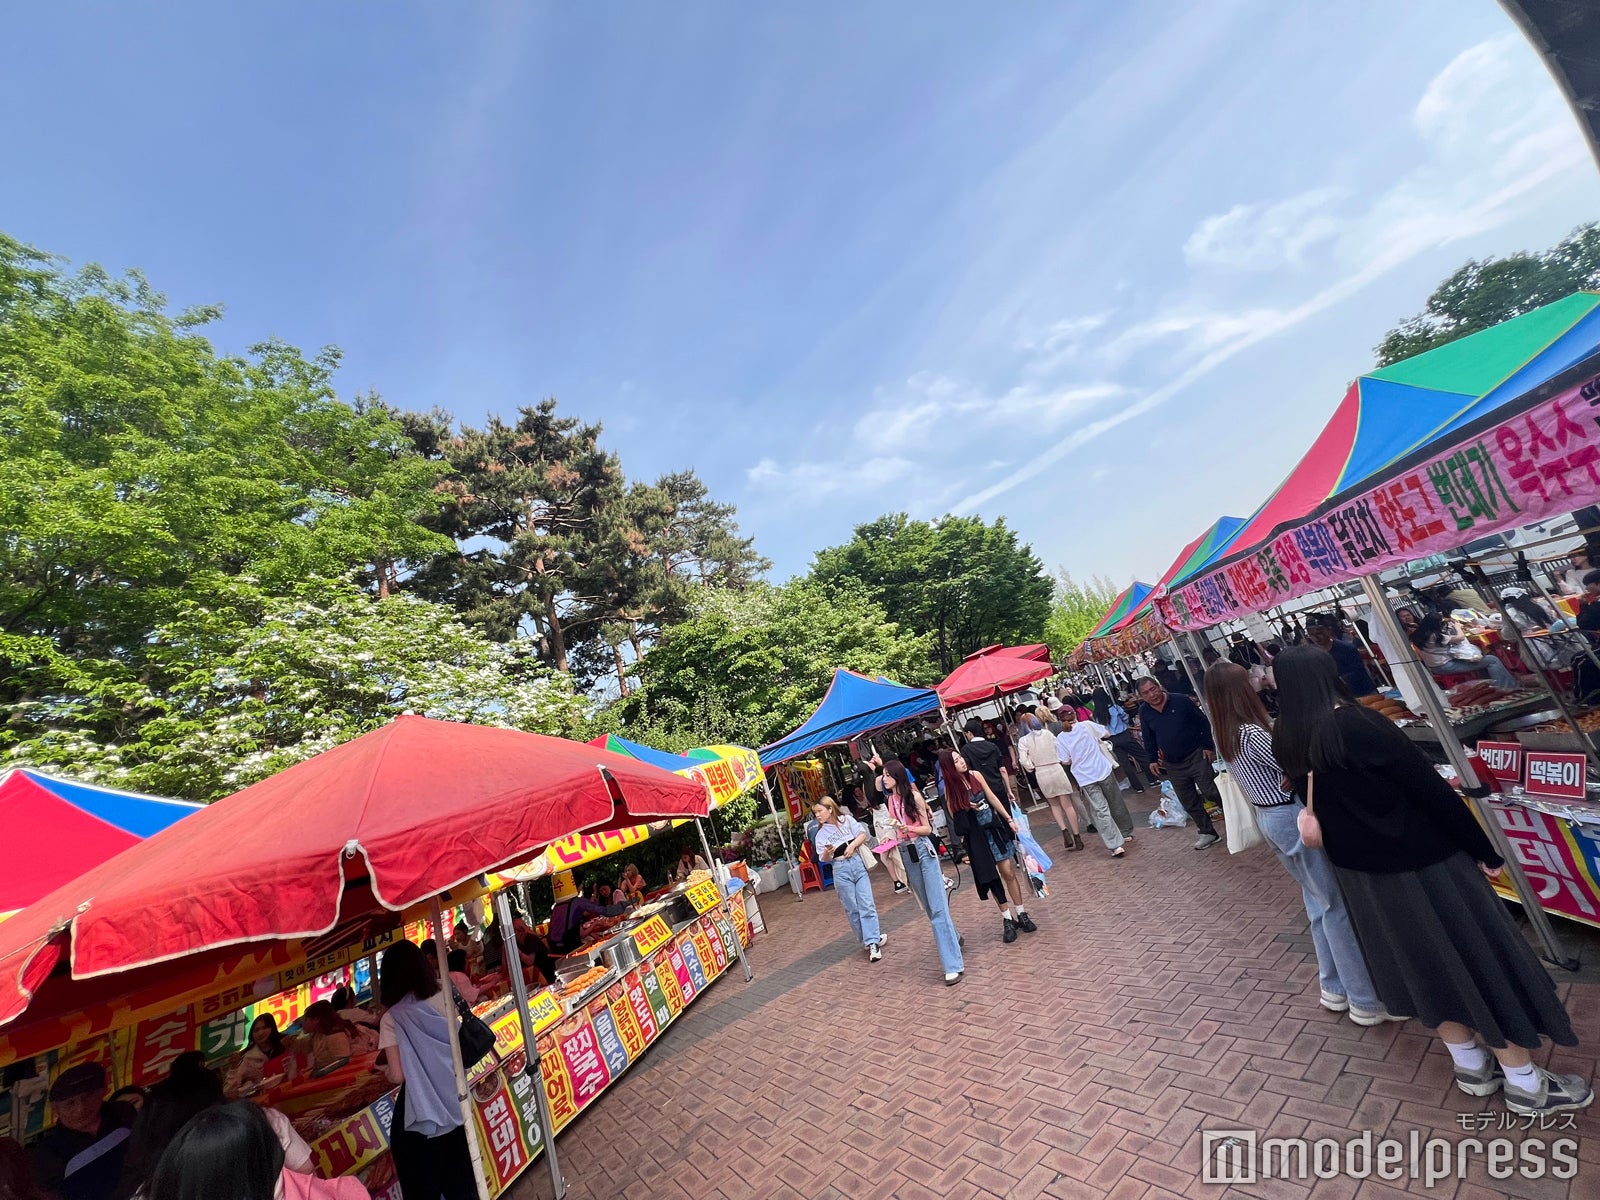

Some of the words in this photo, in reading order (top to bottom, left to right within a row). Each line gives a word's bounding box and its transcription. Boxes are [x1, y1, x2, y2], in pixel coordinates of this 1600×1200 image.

[1275, 533, 1311, 584] 오뎅
[1294, 520, 1348, 577] 떡볶이
[1372, 474, 1447, 552] 핫도그
[1426, 440, 1521, 532] 번데기
[1495, 400, 1600, 503] 옥수수
[703, 760, 738, 799] 떡볶이
[1530, 760, 1580, 788] 떡볶이
[633, 919, 669, 947] 떡볶이
[682, 943, 703, 986] 옥수수
[696, 934, 716, 976] 번데기
[529, 997, 557, 1027] 떡소떡
[629, 984, 656, 1041] 핫도그
[596, 1014, 625, 1071] 음료수
[483, 1095, 522, 1178] 번데기
